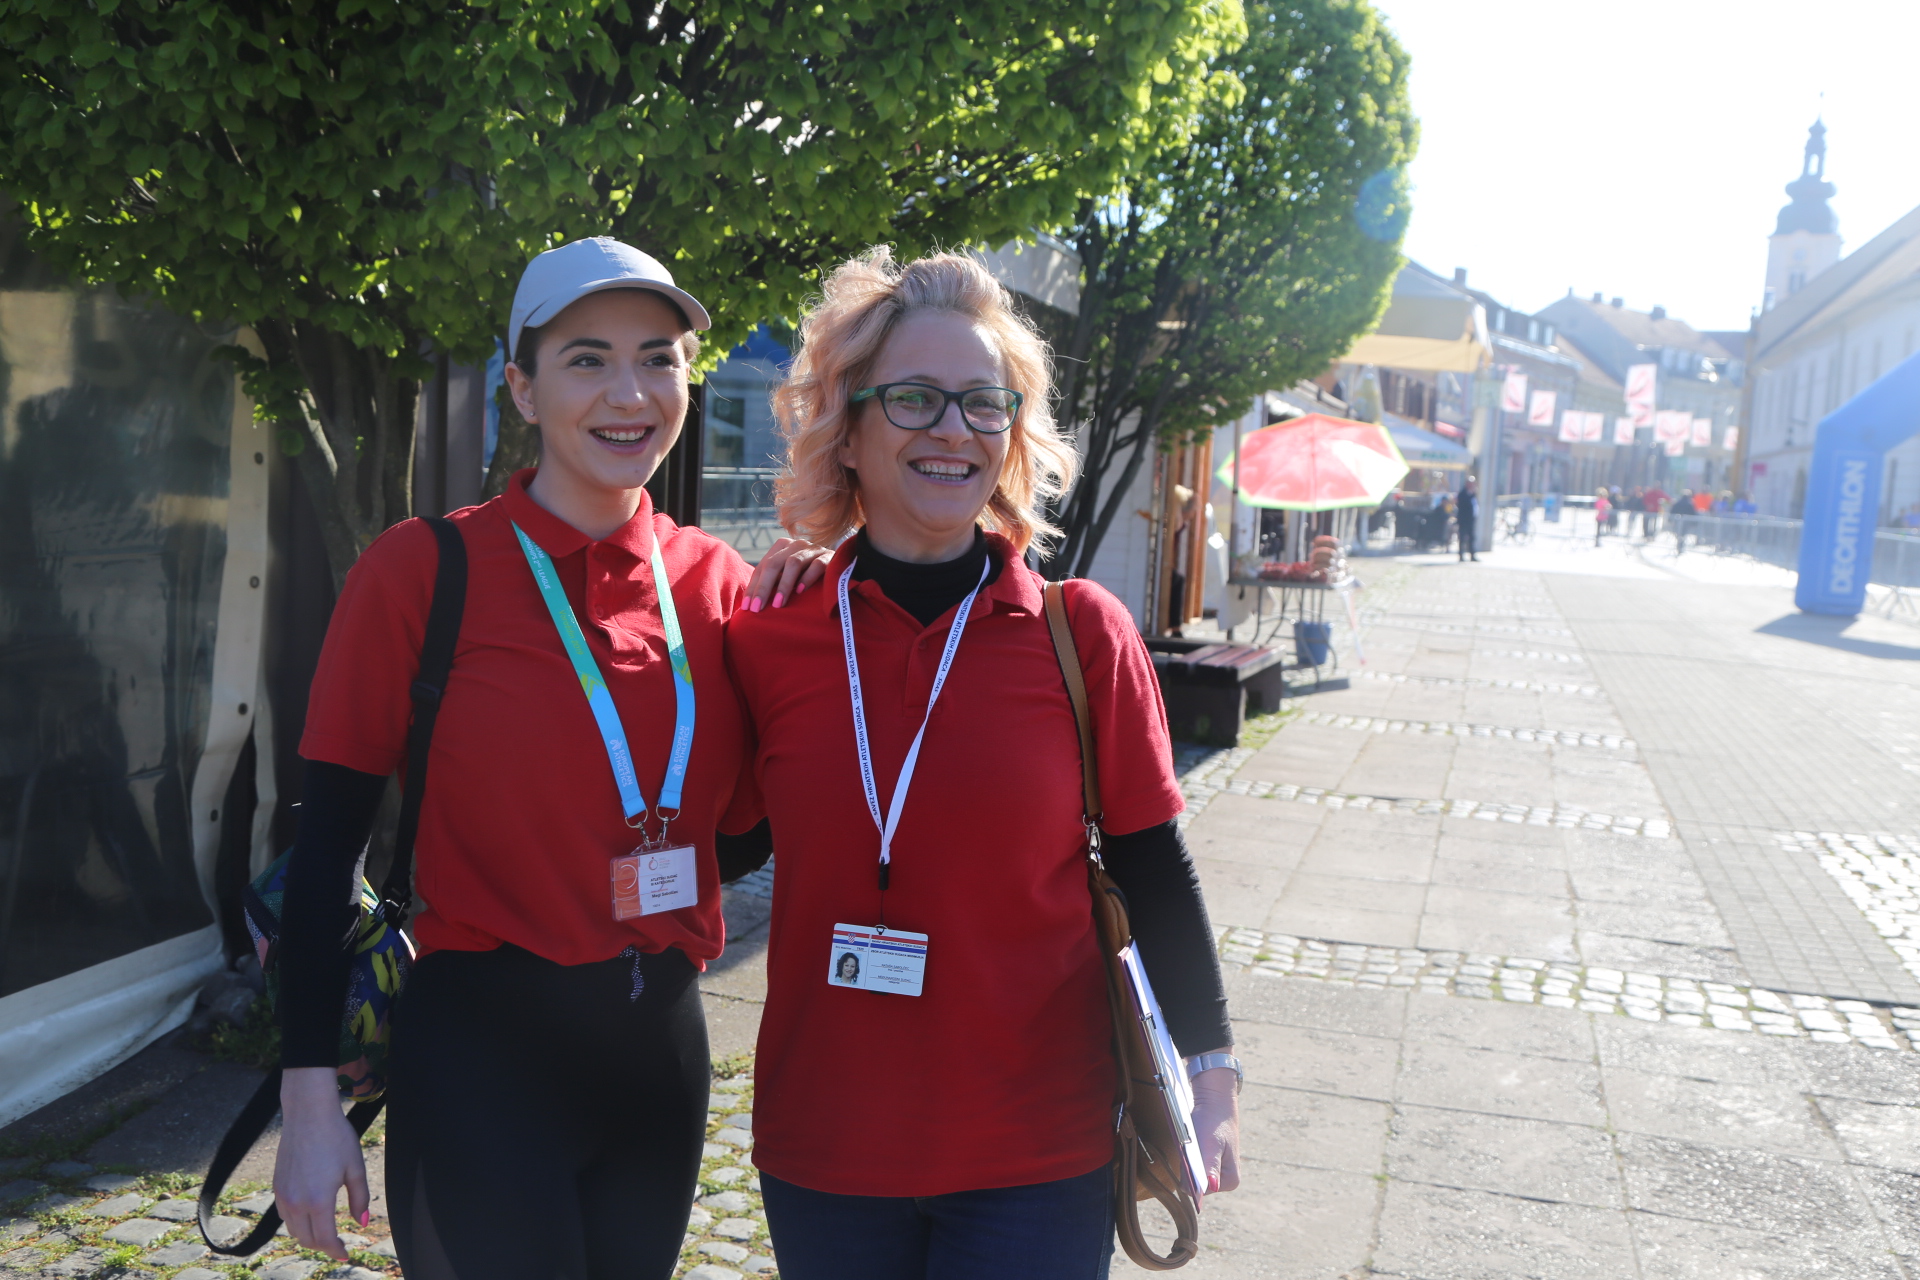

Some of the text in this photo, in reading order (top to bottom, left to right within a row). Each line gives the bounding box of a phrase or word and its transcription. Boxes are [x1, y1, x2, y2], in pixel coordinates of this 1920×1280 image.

[1830, 460, 1867, 593] DECATHLON
[538, 569, 551, 590] LEAGUE
[842, 599, 850, 627] ATLETSKIH
[845, 629, 853, 660] HRVATSKIH
[950, 621, 962, 649] ATLETSKIH
[941, 649, 953, 672] SUDACA
[855, 706, 863, 729] SUDACA
[673, 725, 685, 762] EUROPEAN
[679, 727, 690, 763] ATHLETICS
[859, 730, 868, 760] ATLETSKIH
[614, 752, 629, 787] ATHLETICS
[619, 749, 633, 786] EUROPEAN
[863, 762, 873, 795] HRVATSKIH
